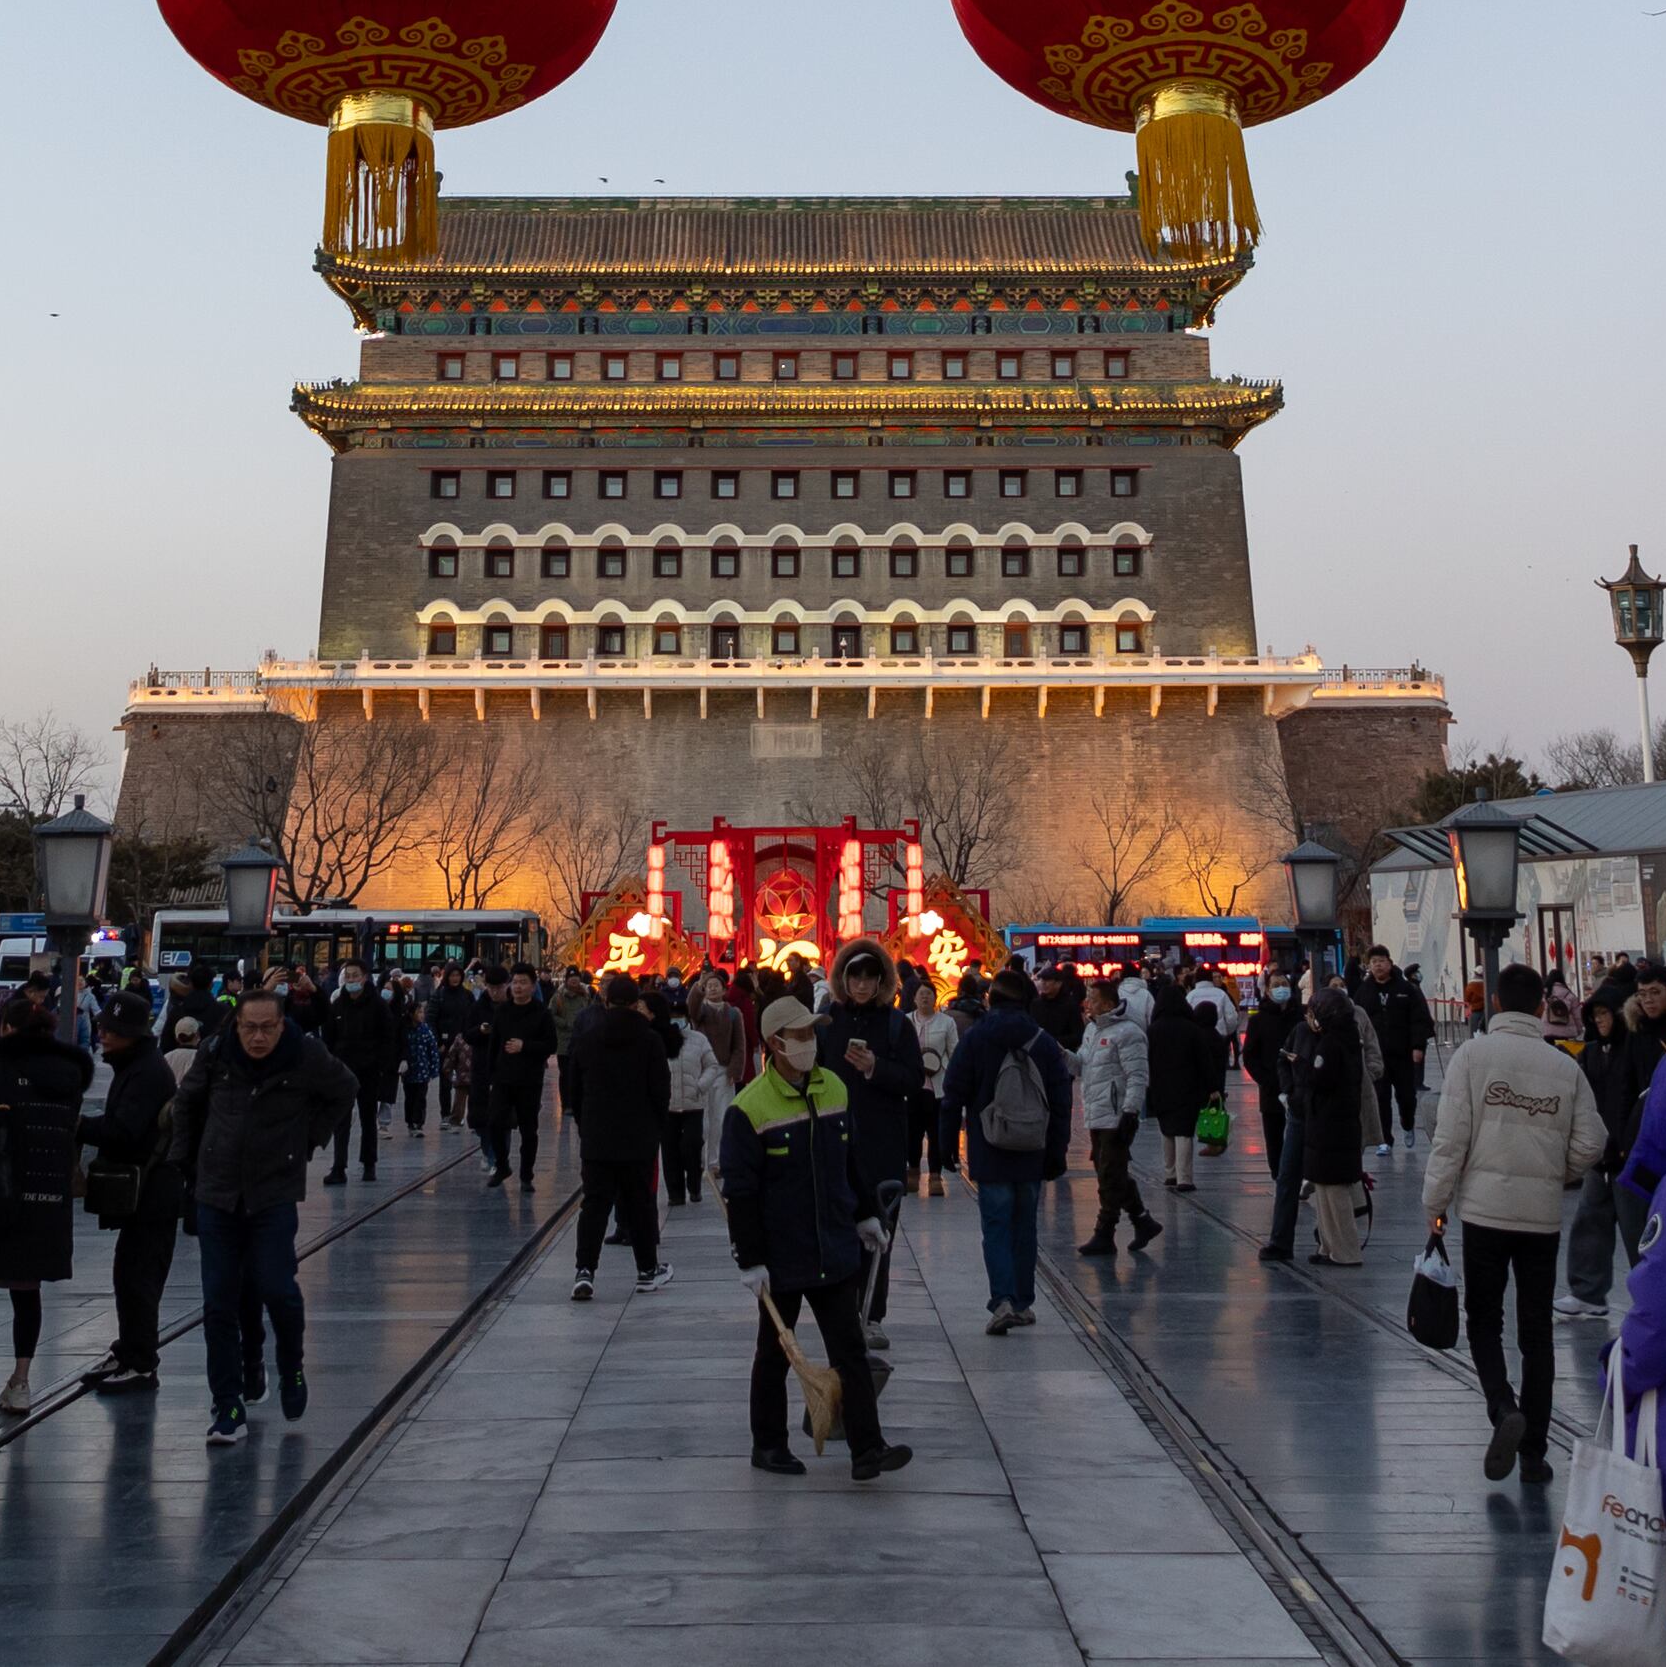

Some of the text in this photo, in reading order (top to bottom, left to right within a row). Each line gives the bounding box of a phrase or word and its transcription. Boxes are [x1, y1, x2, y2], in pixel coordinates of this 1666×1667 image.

[603, 932, 646, 974] 平
[928, 930, 969, 979] 安
[1485, 1081, 1560, 1116] Strength
